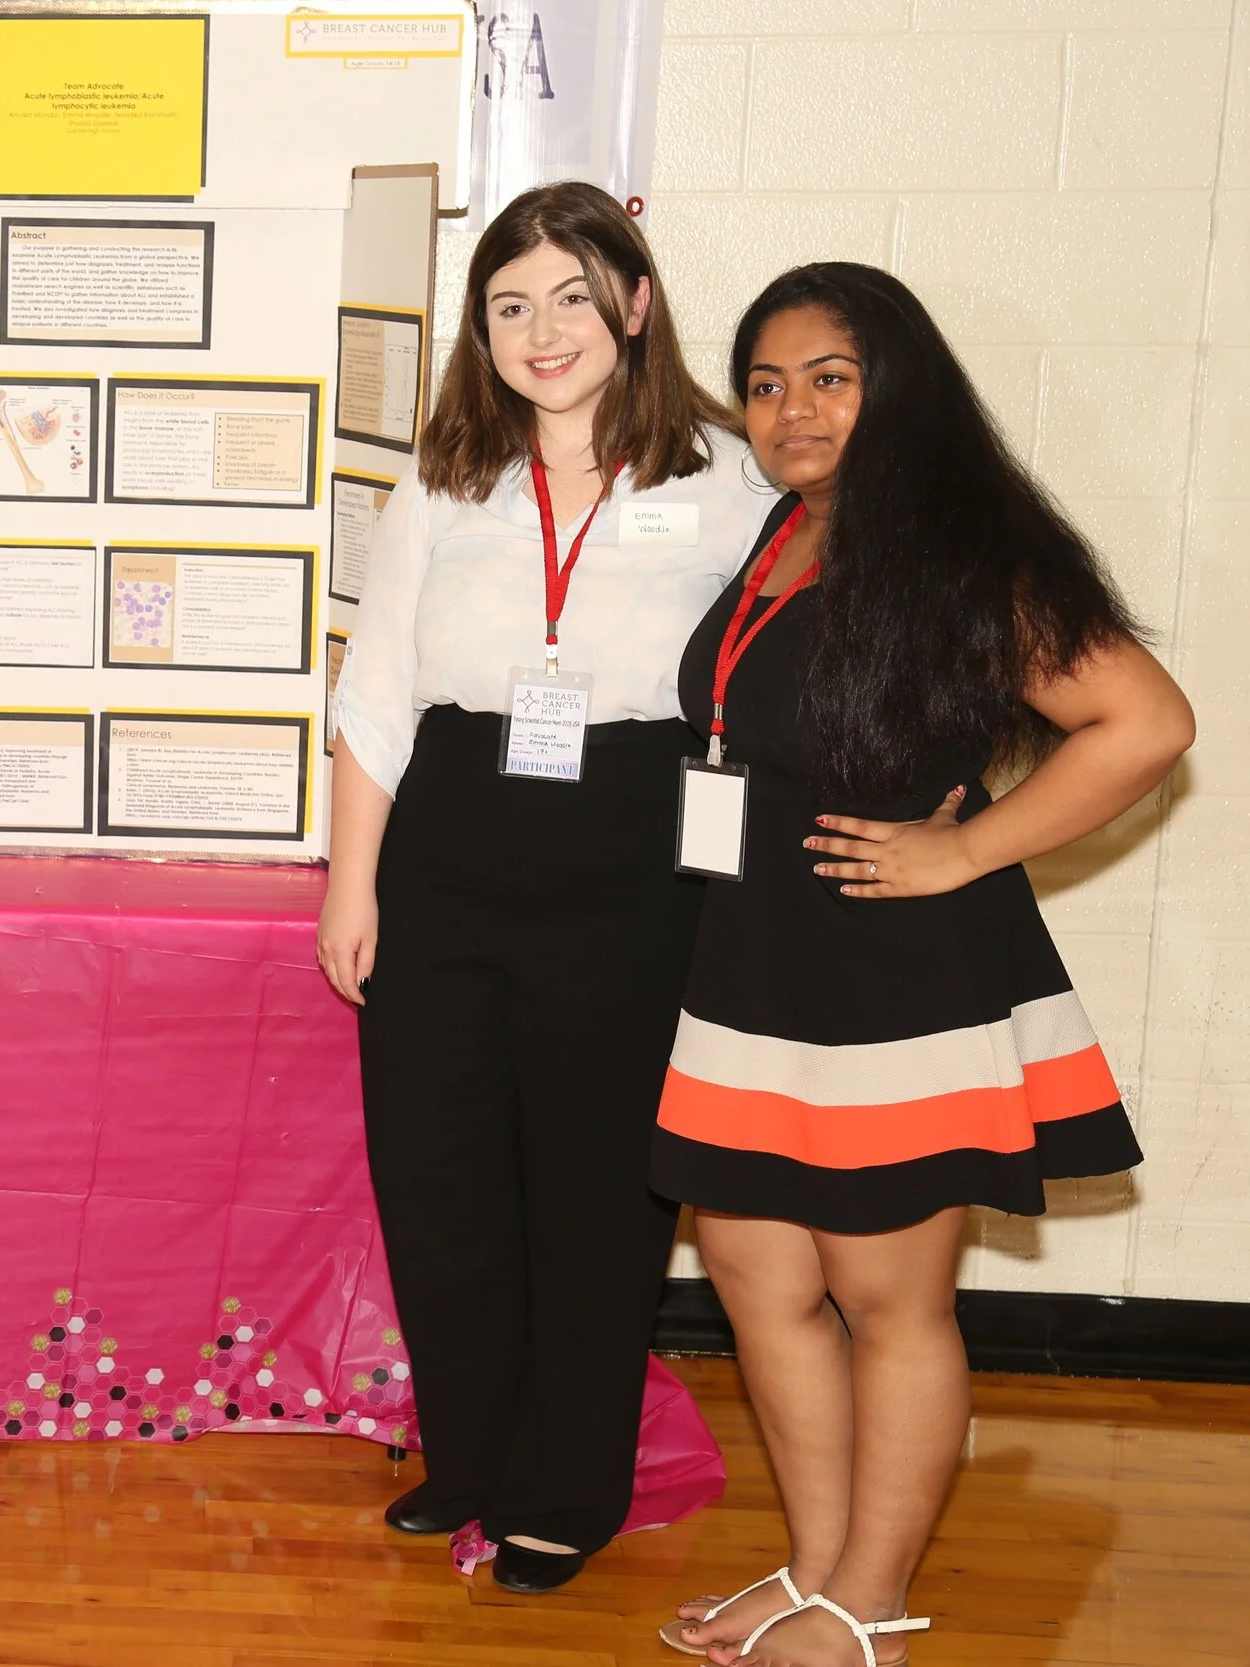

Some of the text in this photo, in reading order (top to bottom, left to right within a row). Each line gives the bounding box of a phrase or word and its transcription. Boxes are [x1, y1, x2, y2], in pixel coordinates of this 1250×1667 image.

[322, 24, 447, 33] BREAST CANCER HUB
[48, 93, 100, 101] lymphoblastic
[11, 231, 46, 240] Abstract
[543, 692, 578, 701] BREAST
[541, 700, 580, 709] CANCER
[541, 708, 561, 716] HUB
[112, 728, 172, 739] References
[510, 760, 573, 774] PARTICIPANT
